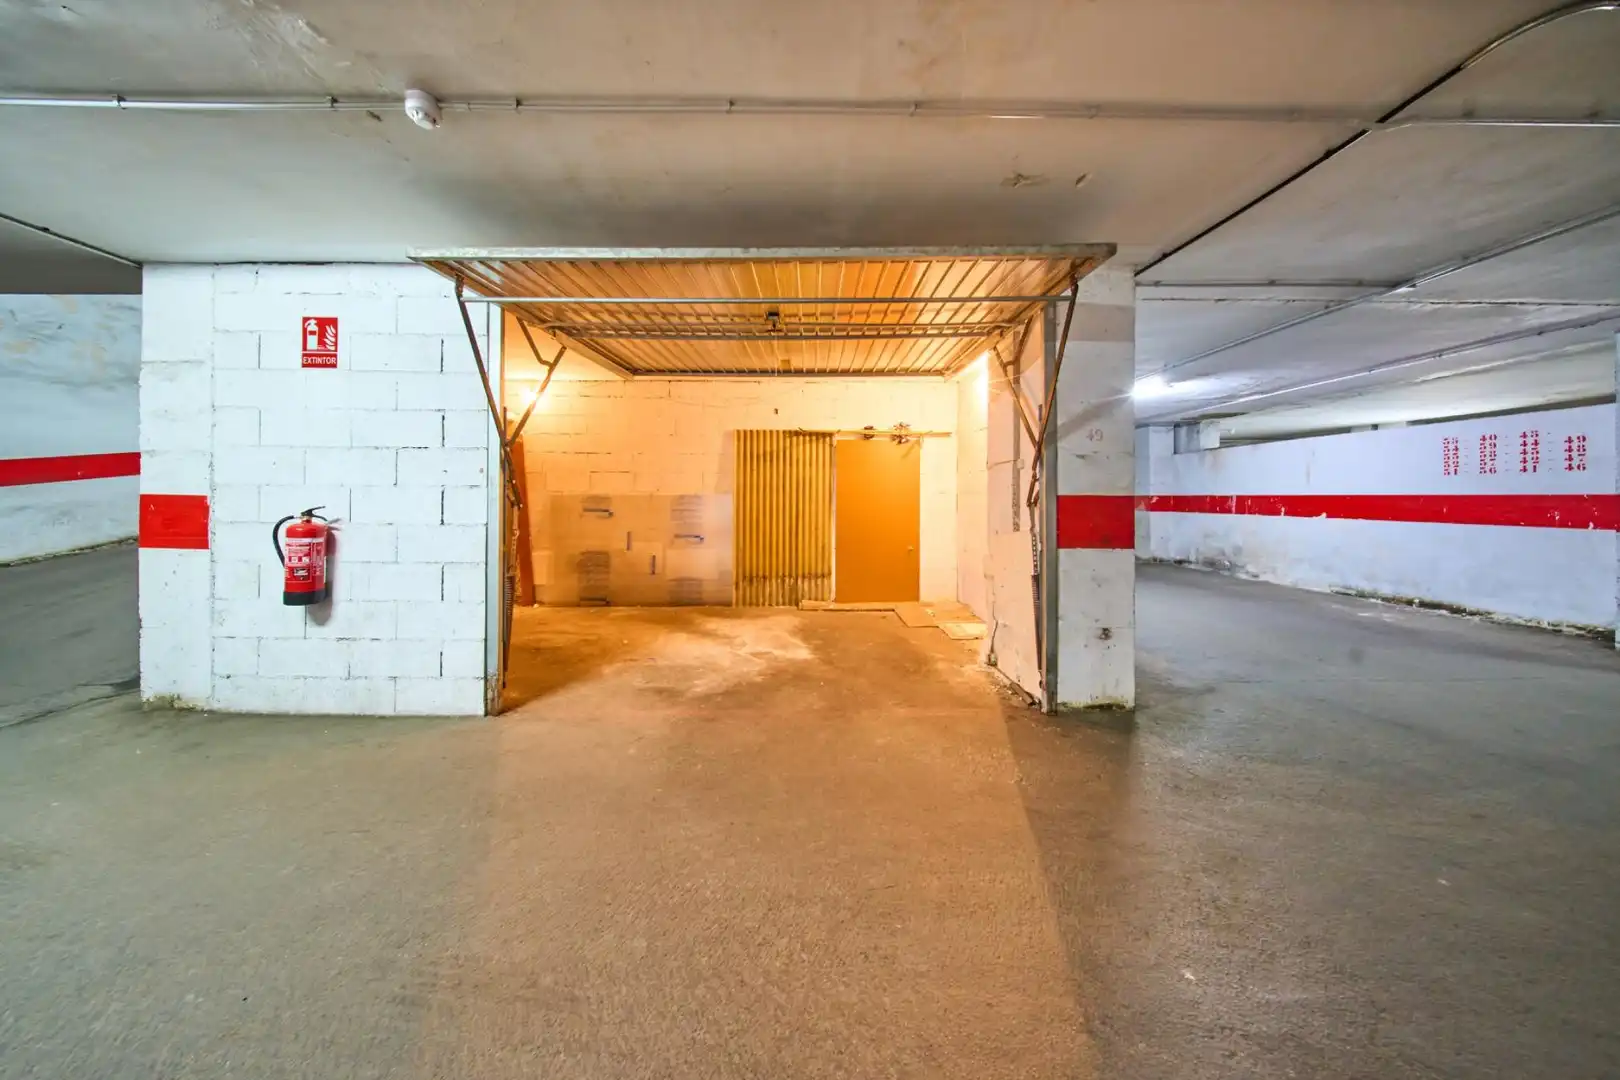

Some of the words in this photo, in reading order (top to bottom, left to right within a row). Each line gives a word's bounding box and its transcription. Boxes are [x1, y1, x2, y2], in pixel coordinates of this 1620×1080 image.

[303, 356, 337, 365] EXTINTOR
[1519, 439, 1540, 447] 44
[1564, 435, 1587, 443] 49
[1519, 465, 1538, 473] 41
[1564, 463, 1587, 471] 46
